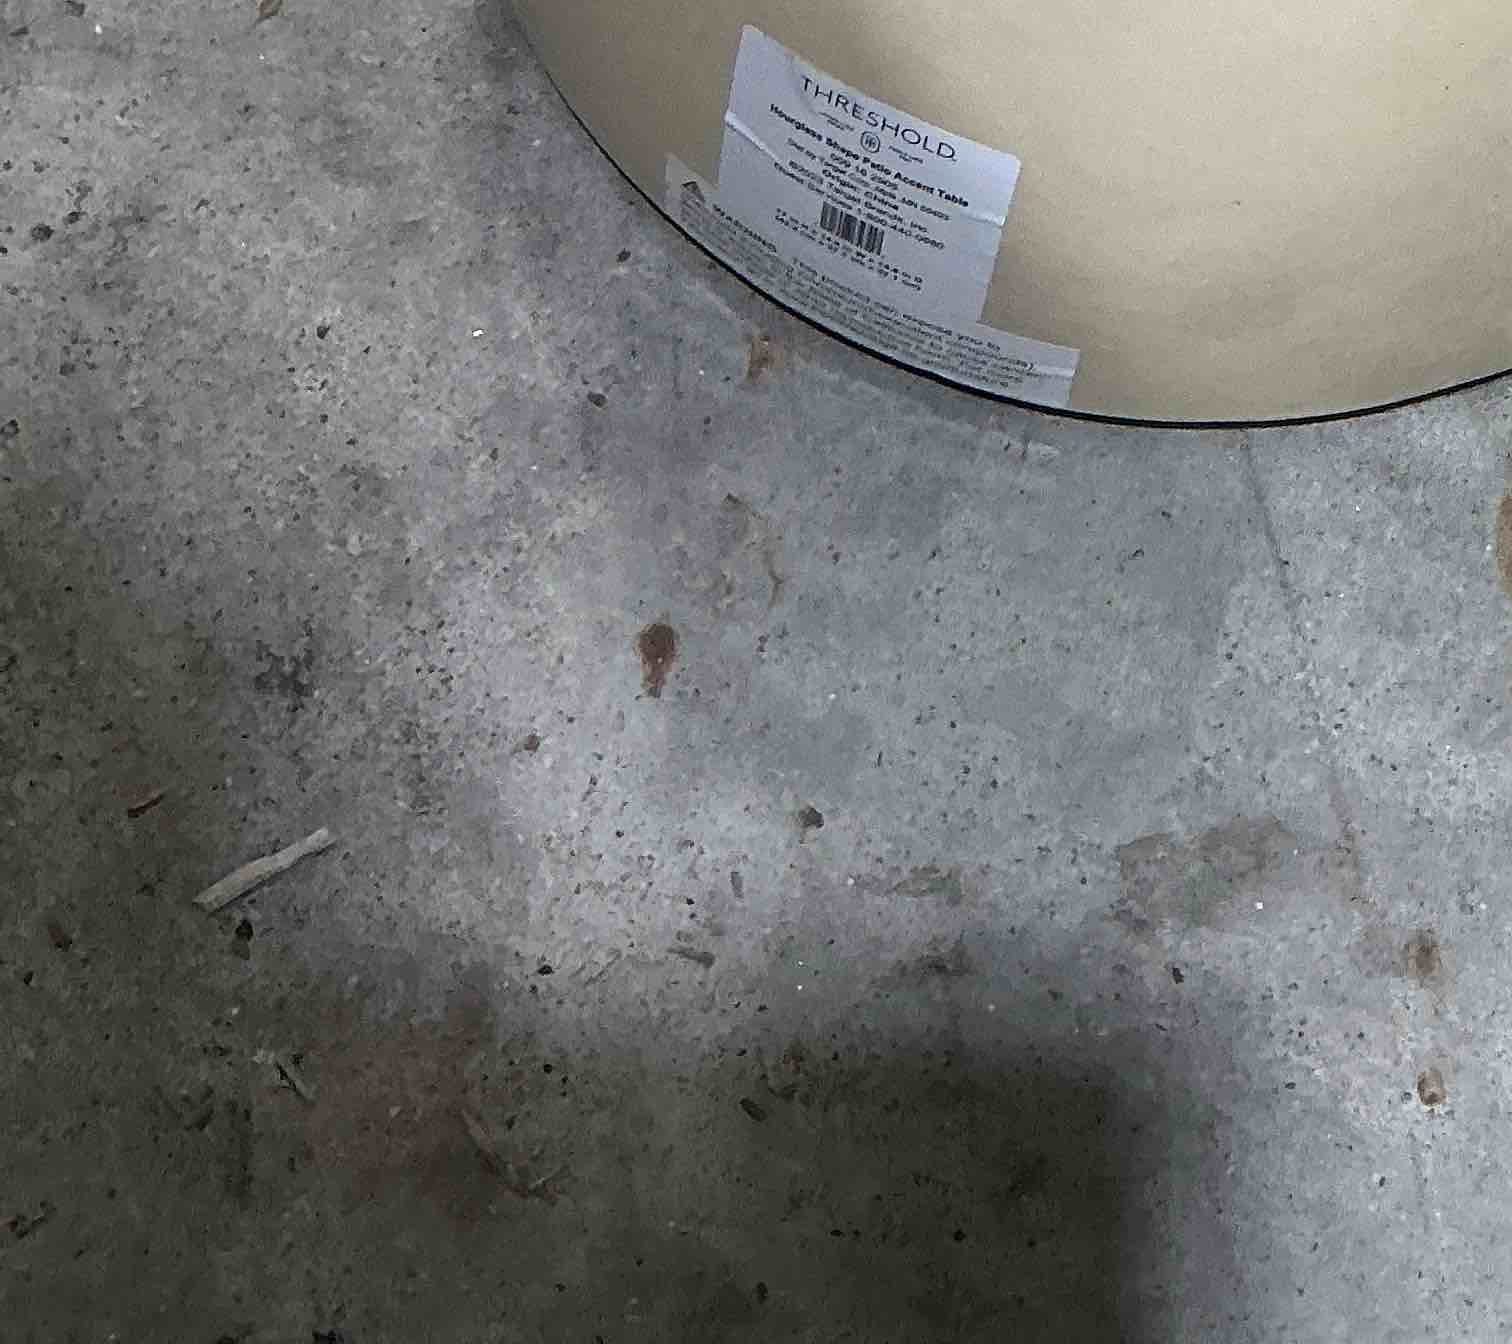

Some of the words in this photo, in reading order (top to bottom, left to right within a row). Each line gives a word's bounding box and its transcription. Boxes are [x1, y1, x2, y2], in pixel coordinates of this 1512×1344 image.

[769, 102, 823, 142] Hourglass
[825, 137, 860, 161] Shape
[862, 156, 892, 177] Patio
[894, 171, 935, 195] Accent
[938, 188, 969, 208] Table
[801, 73, 955, 160] THRESHOLD
